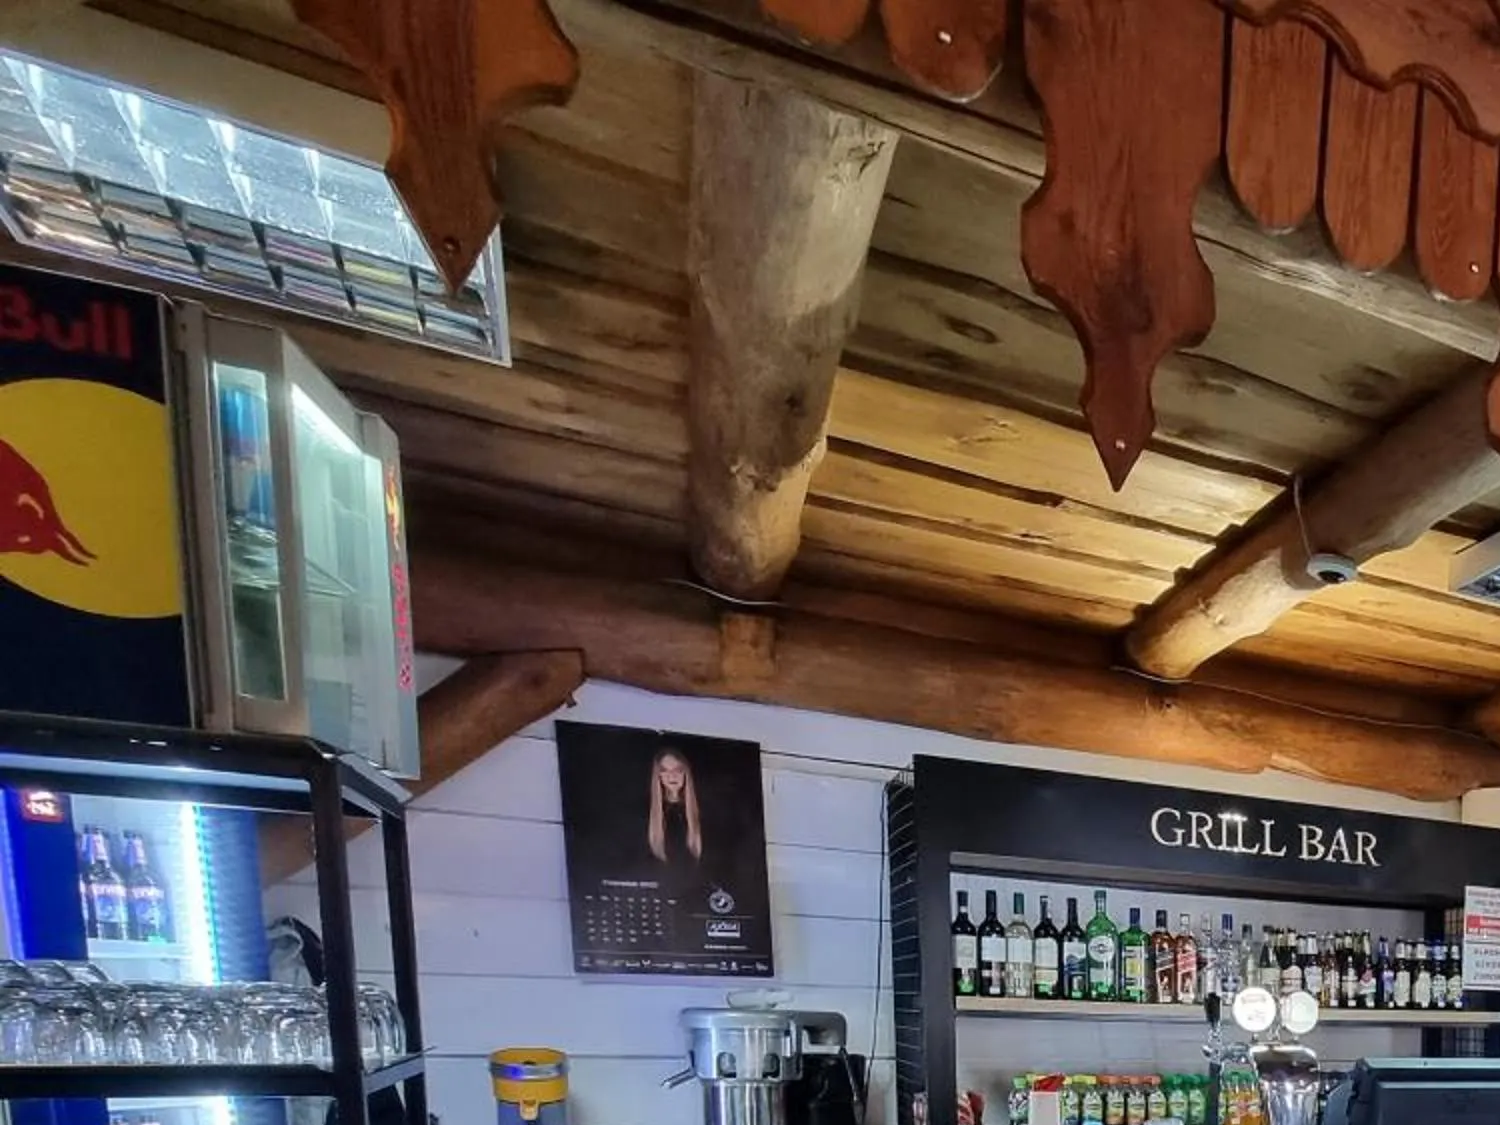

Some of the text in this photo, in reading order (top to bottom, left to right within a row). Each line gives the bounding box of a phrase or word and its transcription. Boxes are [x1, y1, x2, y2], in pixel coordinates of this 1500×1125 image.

[0, 283, 133, 361] Bull
[1151, 807, 1381, 867] GRILL BAR
